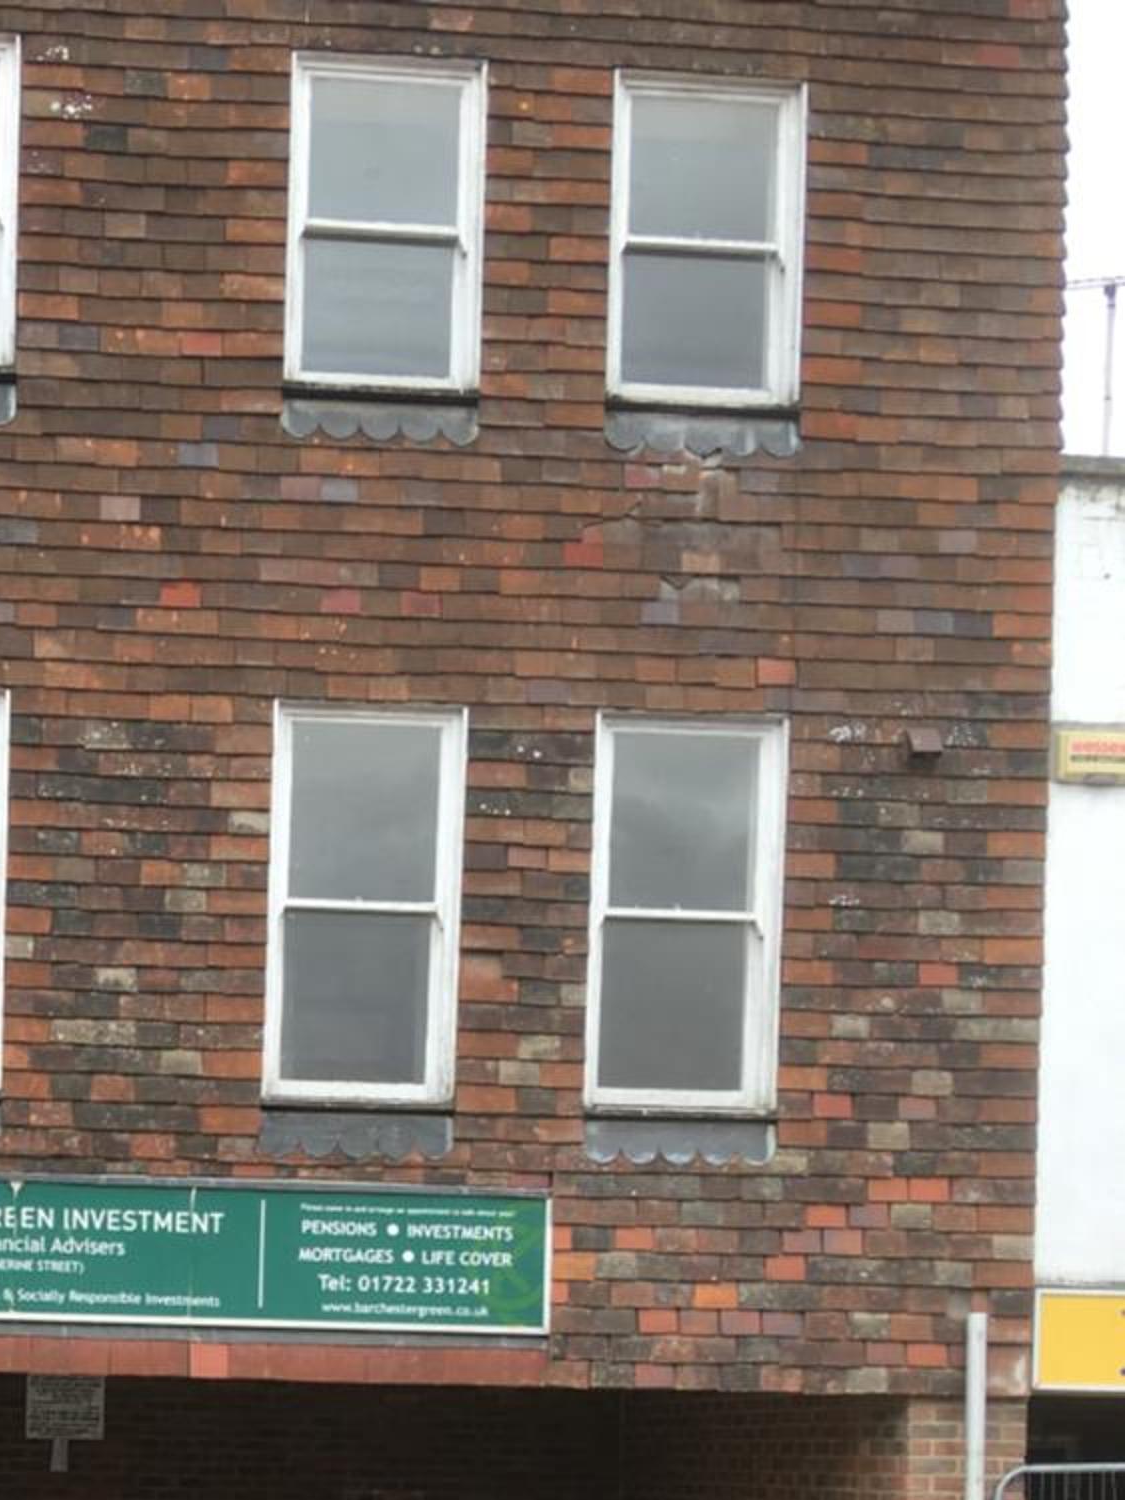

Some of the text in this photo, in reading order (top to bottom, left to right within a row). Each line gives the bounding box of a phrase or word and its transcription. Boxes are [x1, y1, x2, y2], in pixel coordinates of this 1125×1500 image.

[63, 1209, 224, 1233] INVESTMENT
[301, 1219, 513, 1239] PENSIONS INVESTMENTS
[50, 1236, 125, 1254] Advisers
[36, 1259, 84, 1273] STREET)
[298, 1247, 512, 1266] MORTGAGES LIFE COVER
[318, 1273, 490, 1294] Tel: 01722 331241
[17, 1288, 64, 1303] Socially
[69, 1290, 140, 1304] Responsible
[145, 1293, 220, 1307] Investments
[321, 1300, 489, 1317] www.barchestergreen.co.uk
